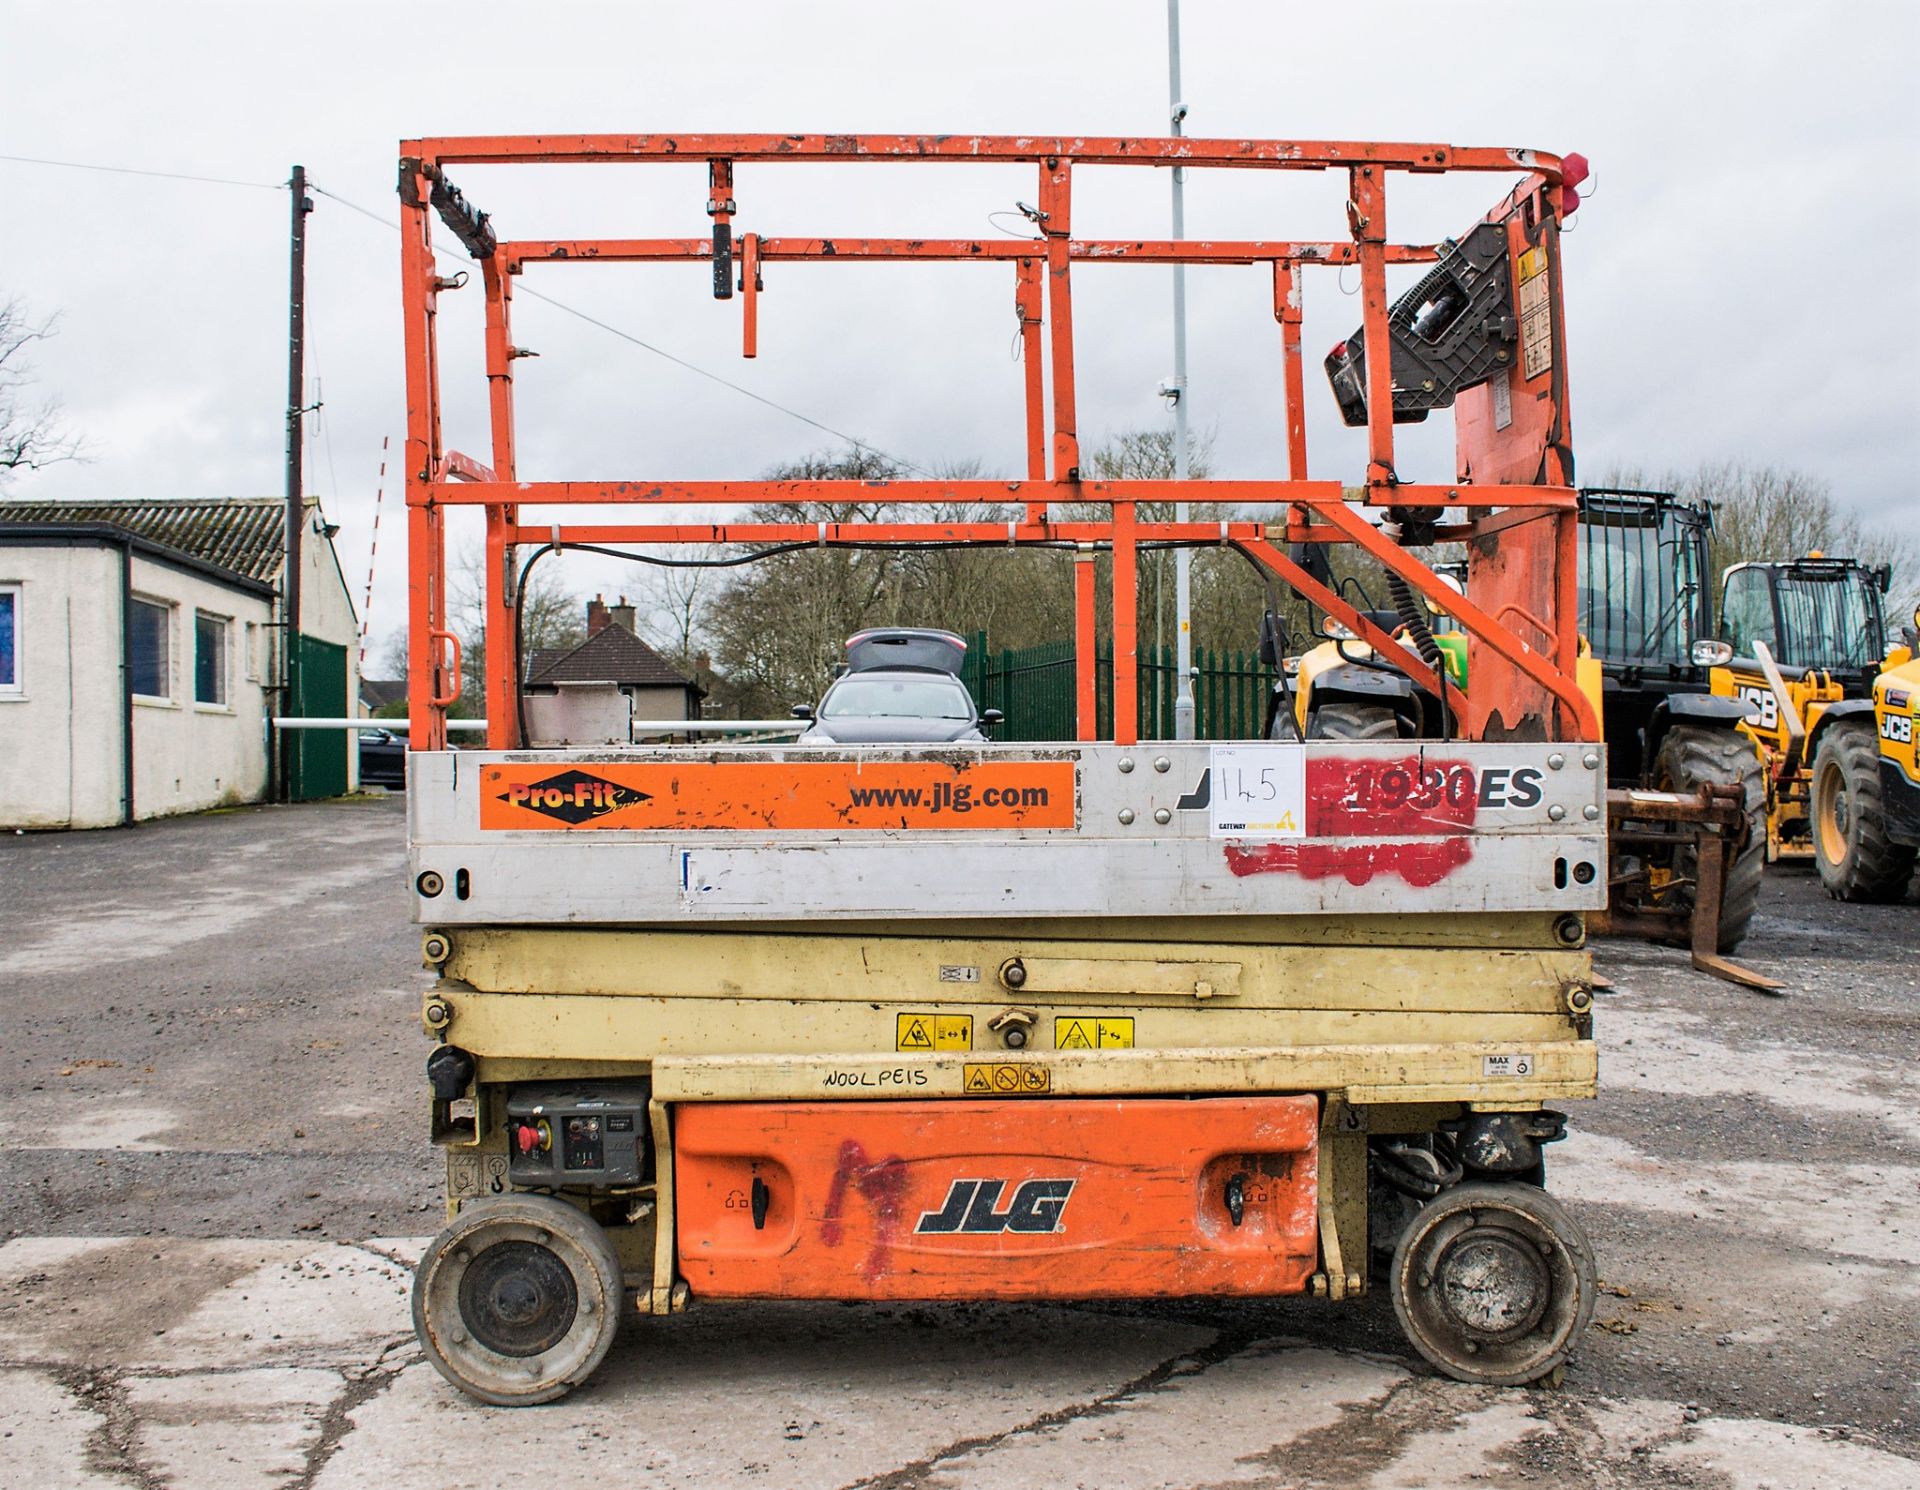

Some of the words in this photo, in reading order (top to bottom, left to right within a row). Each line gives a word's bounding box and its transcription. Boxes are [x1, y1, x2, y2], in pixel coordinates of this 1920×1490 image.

[1881, 714, 1912, 743] JCB
[507, 782, 618, 808] Pro-Fit
[849, 782, 1049, 813] www.jlg.com
[1222, 767, 1277, 803] 145
[1489, 1056, 1509, 1064] MAX
[913, 1177, 1077, 1235] JLG
